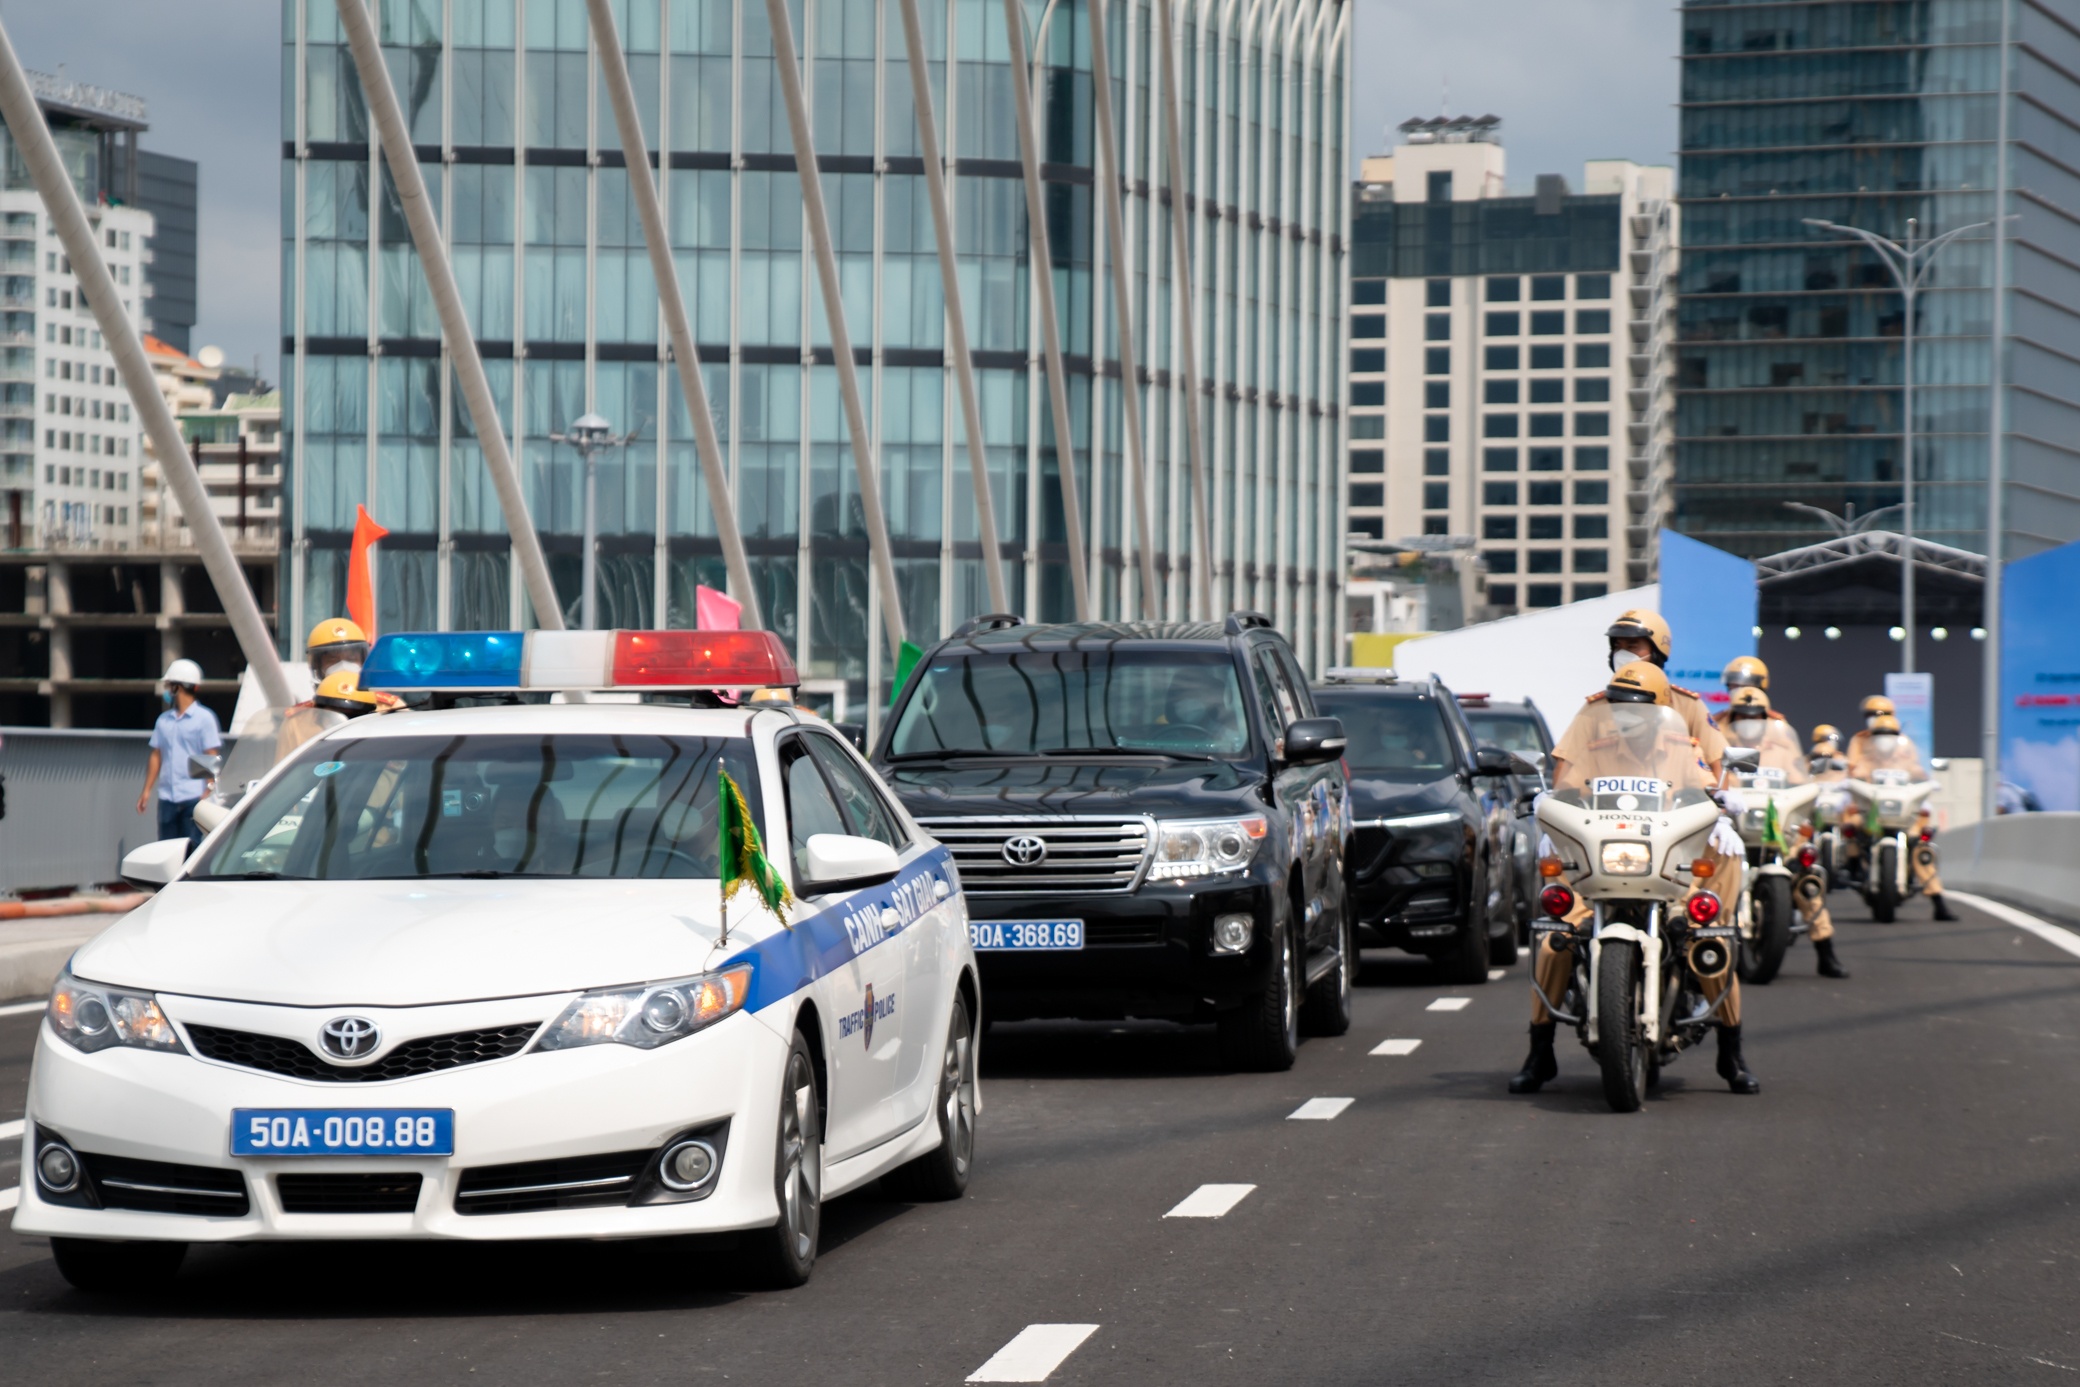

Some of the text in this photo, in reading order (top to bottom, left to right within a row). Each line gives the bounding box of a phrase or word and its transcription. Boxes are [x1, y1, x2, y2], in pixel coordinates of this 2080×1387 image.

[1597, 779, 1658, 794] POLICE
[1598, 814, 1653, 823] HONDA
[839, 993, 895, 1040] TRAFFIC POLICE
[249, 1116, 436, 1148] 50A-008.88
